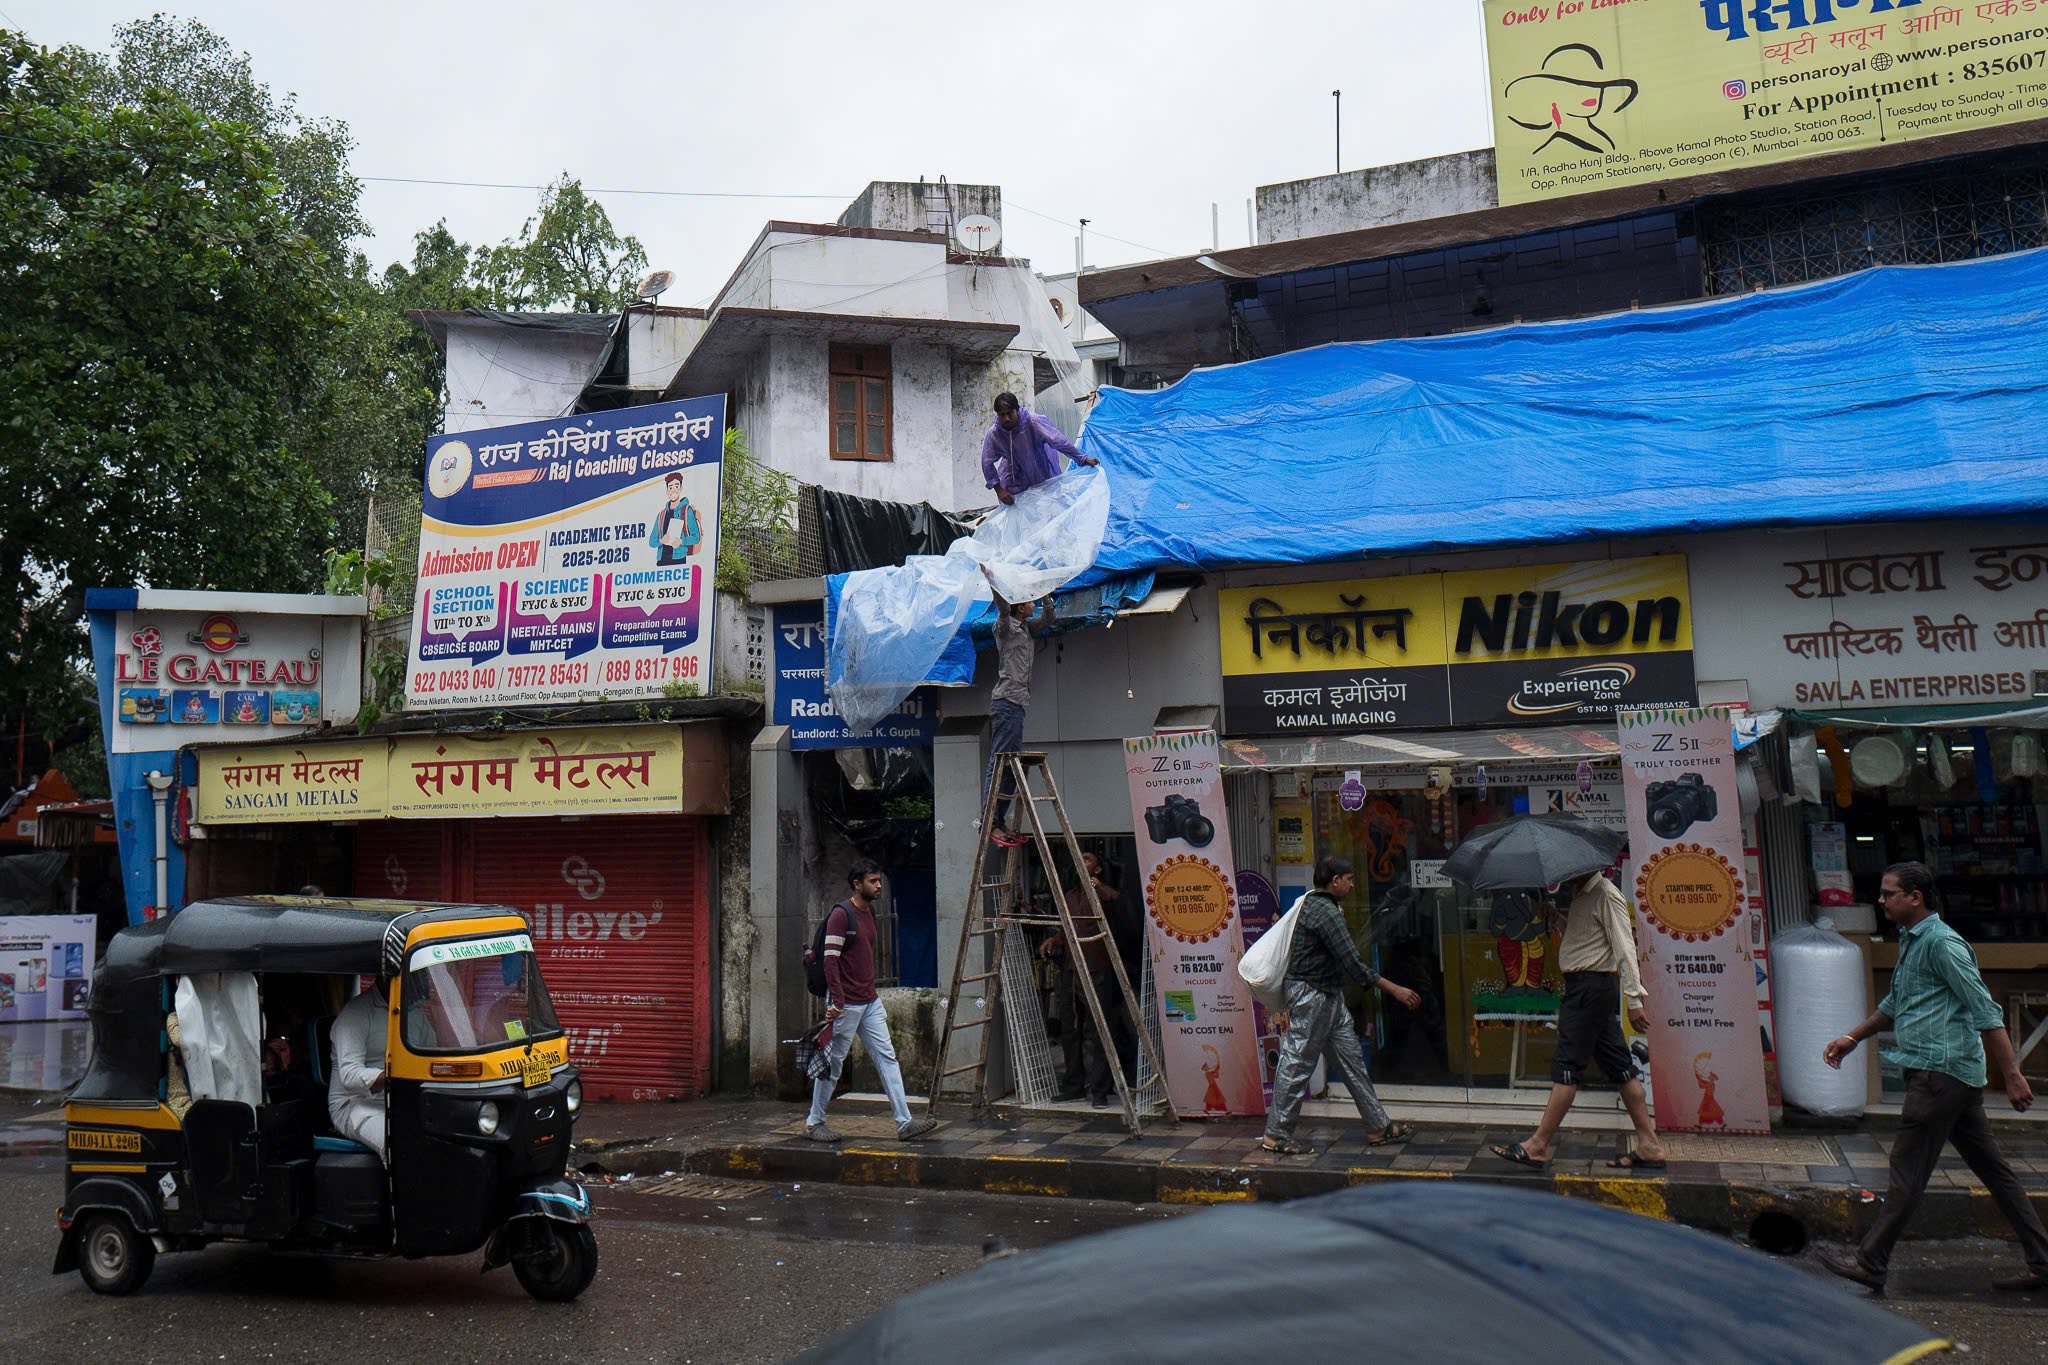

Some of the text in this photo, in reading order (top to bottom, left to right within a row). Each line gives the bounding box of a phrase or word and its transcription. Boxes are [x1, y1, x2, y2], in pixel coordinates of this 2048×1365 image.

[1502, 7, 1549, 26] Only
[1556, 2, 1585, 20] for
[1899, 6, 1964, 35] आणि
[1743, 50, 2046, 120] For Appointment 835607
[1751, 58, 1867, 93] personaroyal
[1885, 83, 2047, 118] Tuesday to Sunday Time
[1897, 99, 2023, 130] Payment through all
[1520, 110, 1876, 178] 1/A, Radha Kunj Bldg., Above Kamal Photo Studio, Station Road,
[1531, 180, 1558, 190] Opp.
[1561, 172, 1604, 184] Anupam
[1606, 164, 1666, 178] Stationery,
[1668, 151, 1726, 168] Goregaon
[1753, 138, 1799, 154] Mumbai
[1810, 133, 1834, 143] 400
[1837, 126, 1865, 139] 063.
[478, 411, 714, 467] राज कोचिंग क्लासेस
[549, 461, 570, 484] Raj
[575, 451, 644, 479] Coaching
[641, 447, 694, 471] Classes
[549, 523, 646, 547] ACADEMIC YEAR
[421, 540, 541, 578] Admission OPEN
[562, 547, 630, 568] 2025-2026
[614, 567, 690, 586] COMMERCE
[1783, 550, 1946, 599] सावला
[435, 585, 494, 601] SCHOOL
[524, 577, 589, 596] SCIENCE
[617, 586, 686, 602] FYJC & SYJC
[432, 598, 495, 615] SECTION
[521, 596, 587, 611] FYJC & SYJC
[458, 617, 472, 628] TO
[511, 622, 595, 639] NEET/JEE MAINS/
[614, 617, 686, 631] Preparation for All
[1243, 592, 1414, 661] निकॉन
[1454, 590, 1682, 656] Nikon
[530, 638, 573, 651] MHT-CET
[613, 629, 687, 643] Competitive Exams
[1783, 613, 1979, 660] प्लास्टिक थैली
[422, 640, 500, 656] CBSE/ICSE BOARD
[116, 653, 321, 685] LE GATEAU
[414, 655, 699, 693] 922 0433 040 79772 85431 889 8317 996
[409, 697, 427, 706] Padma
[498, 693, 519, 702] Ground
[520, 692, 537, 701] Floor,
[538, 692, 550, 700] Opp
[552, 690, 576, 699] Anupam
[603, 688, 633, 696] Goregaon
[1263, 676, 1408, 709] कमल इमेजिंग
[1522, 677, 1620, 699] Experience
[1594, 690, 1621, 700] Zone
[1795, 672, 2026, 703] SAVLA ENTERPRISES
[1577, 705, 1593, 713] GST
[1596, 705, 1608, 713] NO
[1276, 711, 1396, 728] KAMAL IMAGING
[792, 727, 921, 739] Landlord: K. Gupta
[1651, 733, 1674, 752] Z
[222, 751, 364, 790] संगम मेटल्स
[411, 736, 656, 798] संगम मेटल्स
[1152, 756, 1170, 773] Z
[1634, 757, 1721, 769] TRULY TOGETHER
[1145, 777, 1204, 788] OUTPERFORM
[225, 788, 359, 810] SANGAM METALS
[1565, 791, 1611, 809] KAMAL
[1665, 885, 1694, 893] STARTING
[551, 946, 606, 959] electric
[1682, 993, 1714, 1002] Charger
[1685, 1006, 1714, 1015] Battery
[1180, 1026, 1234, 1035] NO COST EMI
[1667, 1019, 1735, 1027] Get EMI Free
